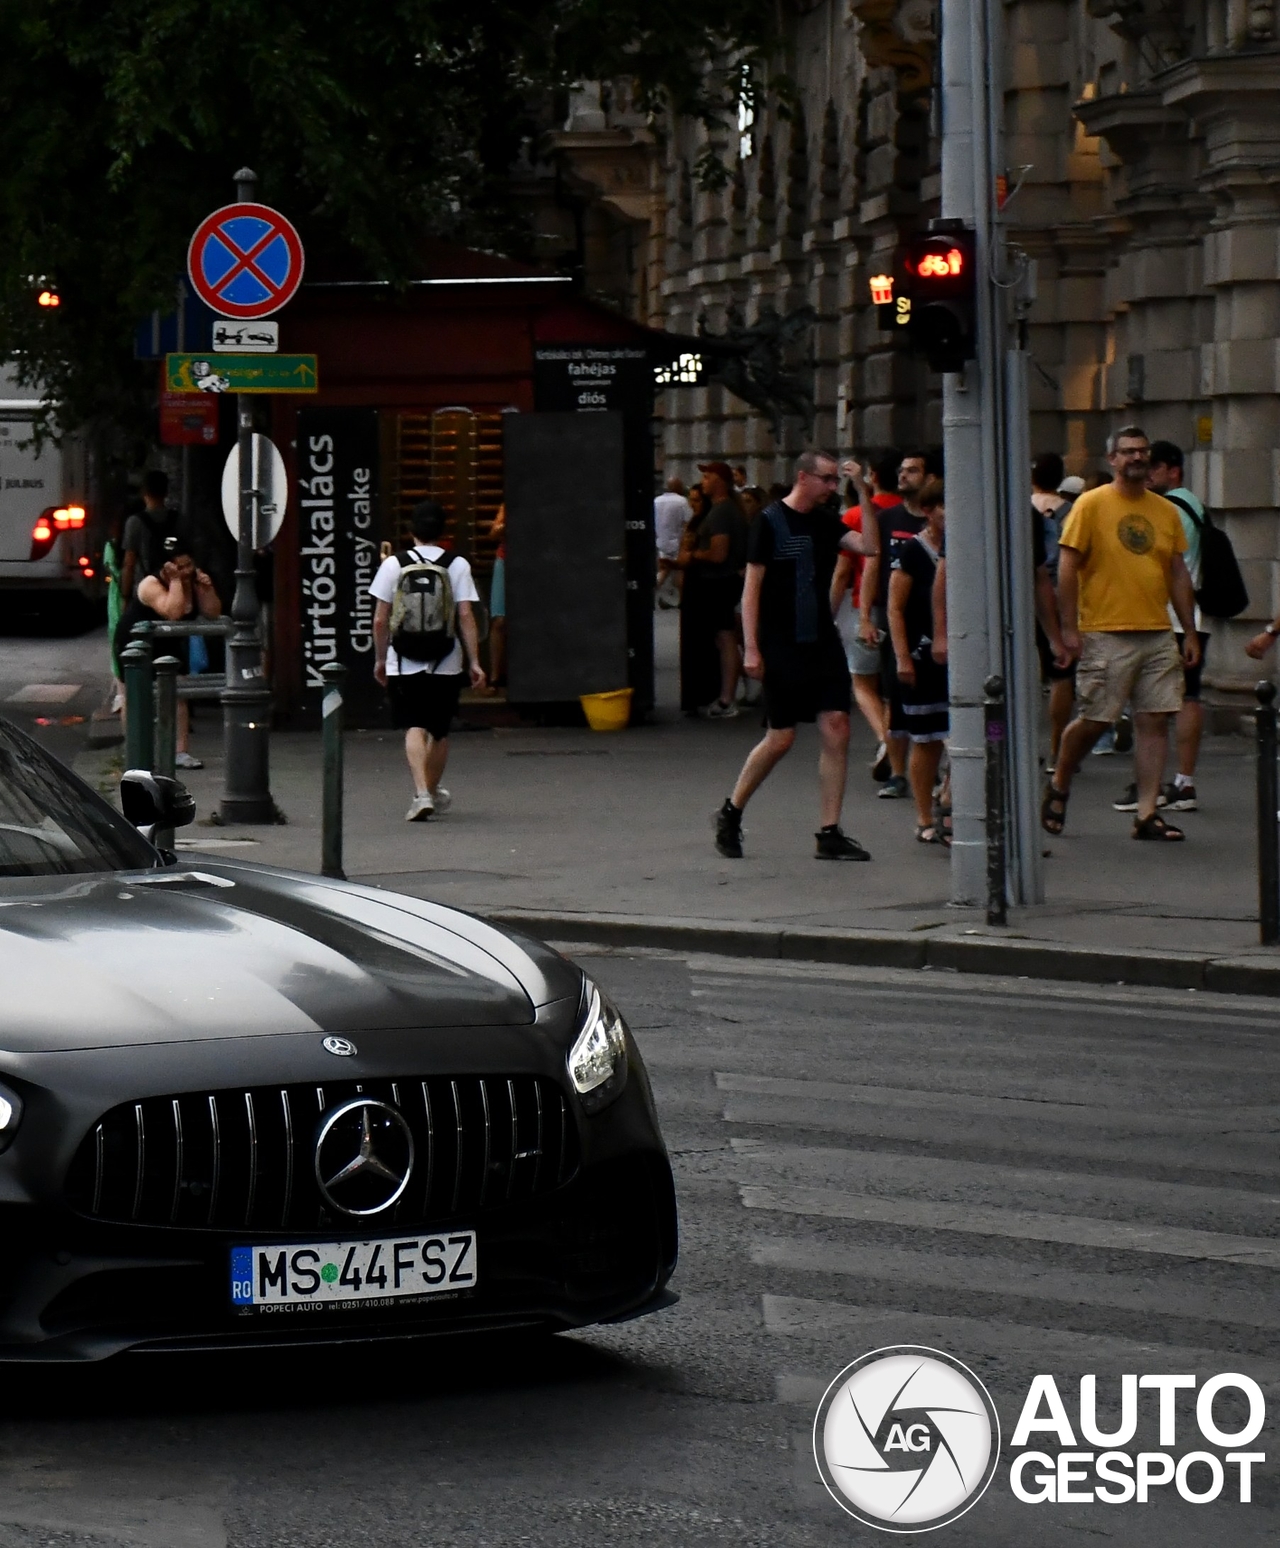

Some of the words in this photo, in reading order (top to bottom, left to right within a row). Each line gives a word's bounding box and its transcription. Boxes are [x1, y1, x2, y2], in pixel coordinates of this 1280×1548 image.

[568, 362, 617, 377] fahéjas
[578, 391, 607, 404] diós
[346, 467, 371, 529] cake
[300, 434, 336, 688] Kürtőskalács
[347, 532, 376, 653] Chimney
[232, 1281, 251, 1299] RO
[259, 1249, 322, 1298] MS
[260, 1303, 295, 1314] POPECI
[296, 1301, 324, 1312] AUTO
[342, 1297, 395, 1310] 0251/410.088
